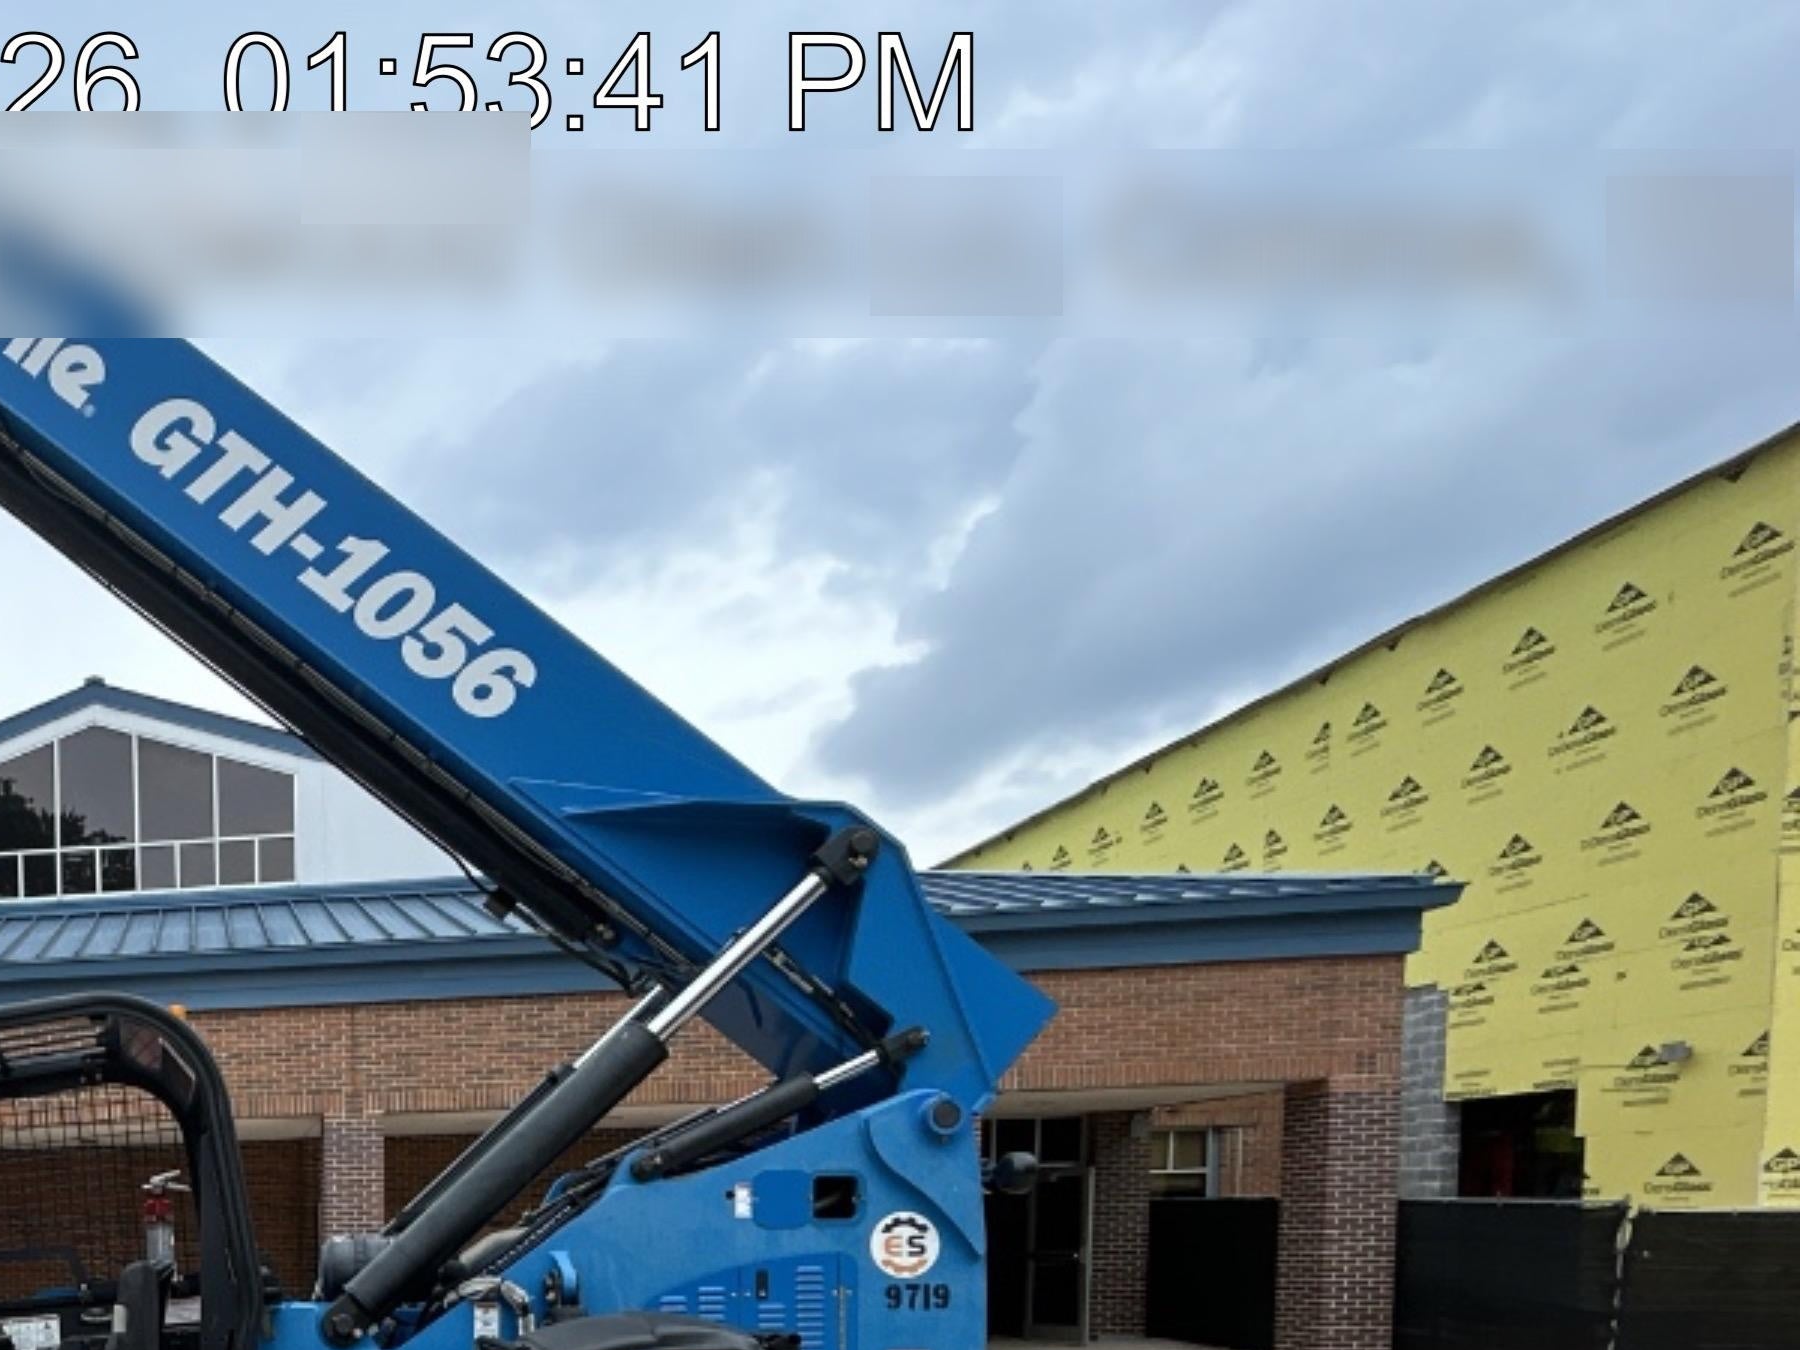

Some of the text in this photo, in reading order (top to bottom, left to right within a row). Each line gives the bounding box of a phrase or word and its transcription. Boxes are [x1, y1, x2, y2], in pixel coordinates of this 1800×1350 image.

[130, 397, 537, 718] GTH-1056
[883, 1234, 927, 1258] ES
[885, 1283, 951, 1311] 9719
